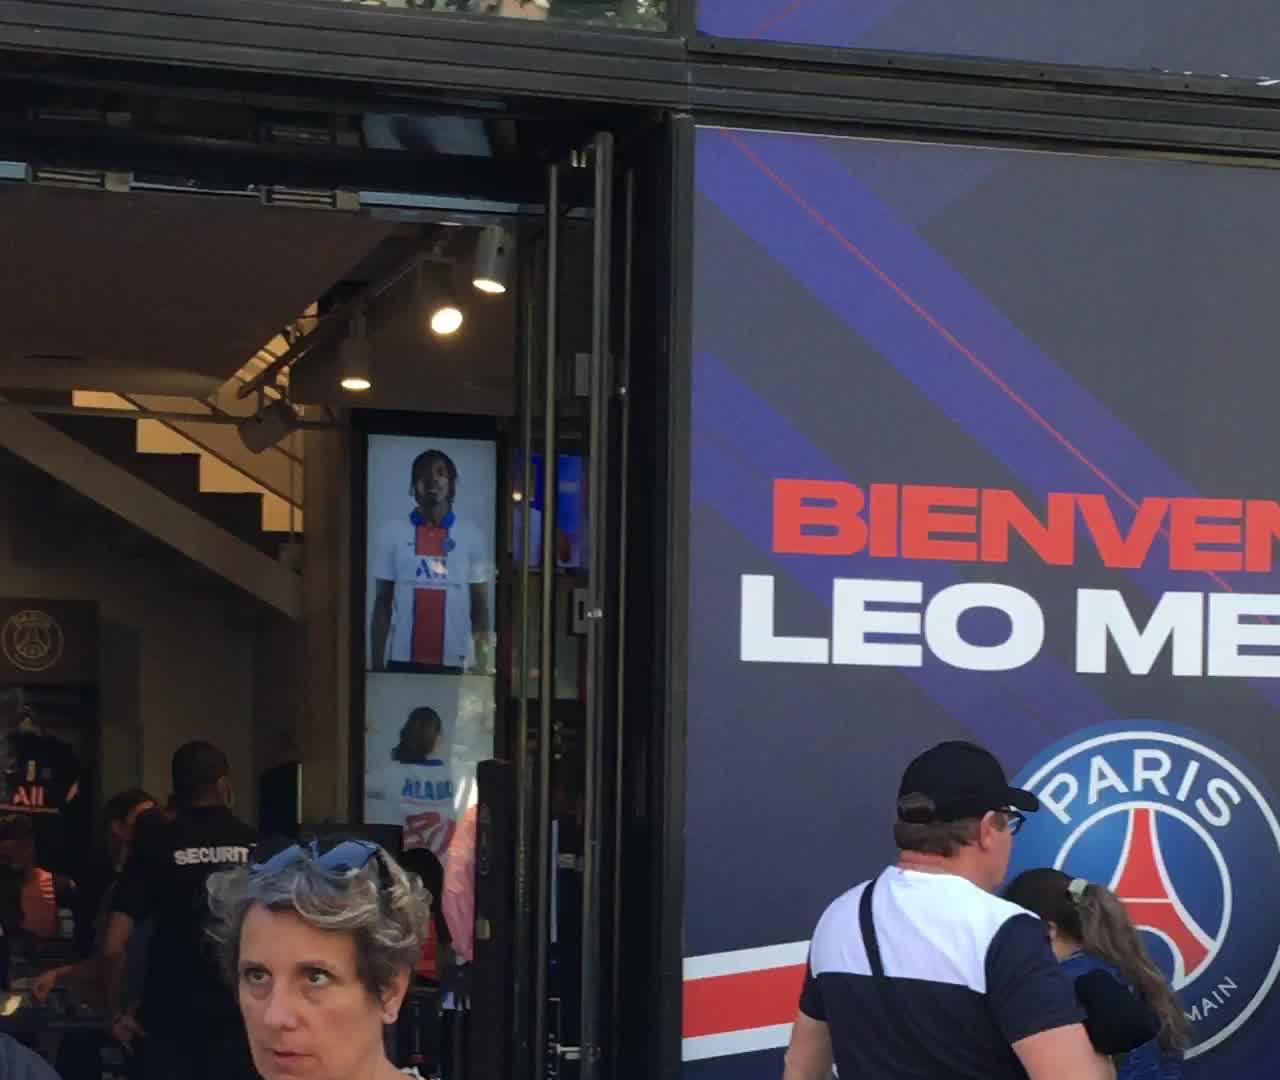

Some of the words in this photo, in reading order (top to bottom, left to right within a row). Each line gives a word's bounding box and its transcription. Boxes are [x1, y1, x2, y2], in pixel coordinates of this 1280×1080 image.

[740, 573, 1045, 671] LEO
[1037, 748, 1242, 828] PARIS
[173, 843, 257, 865] SECURIT
[1183, 975, 1239, 1024] MAIN
